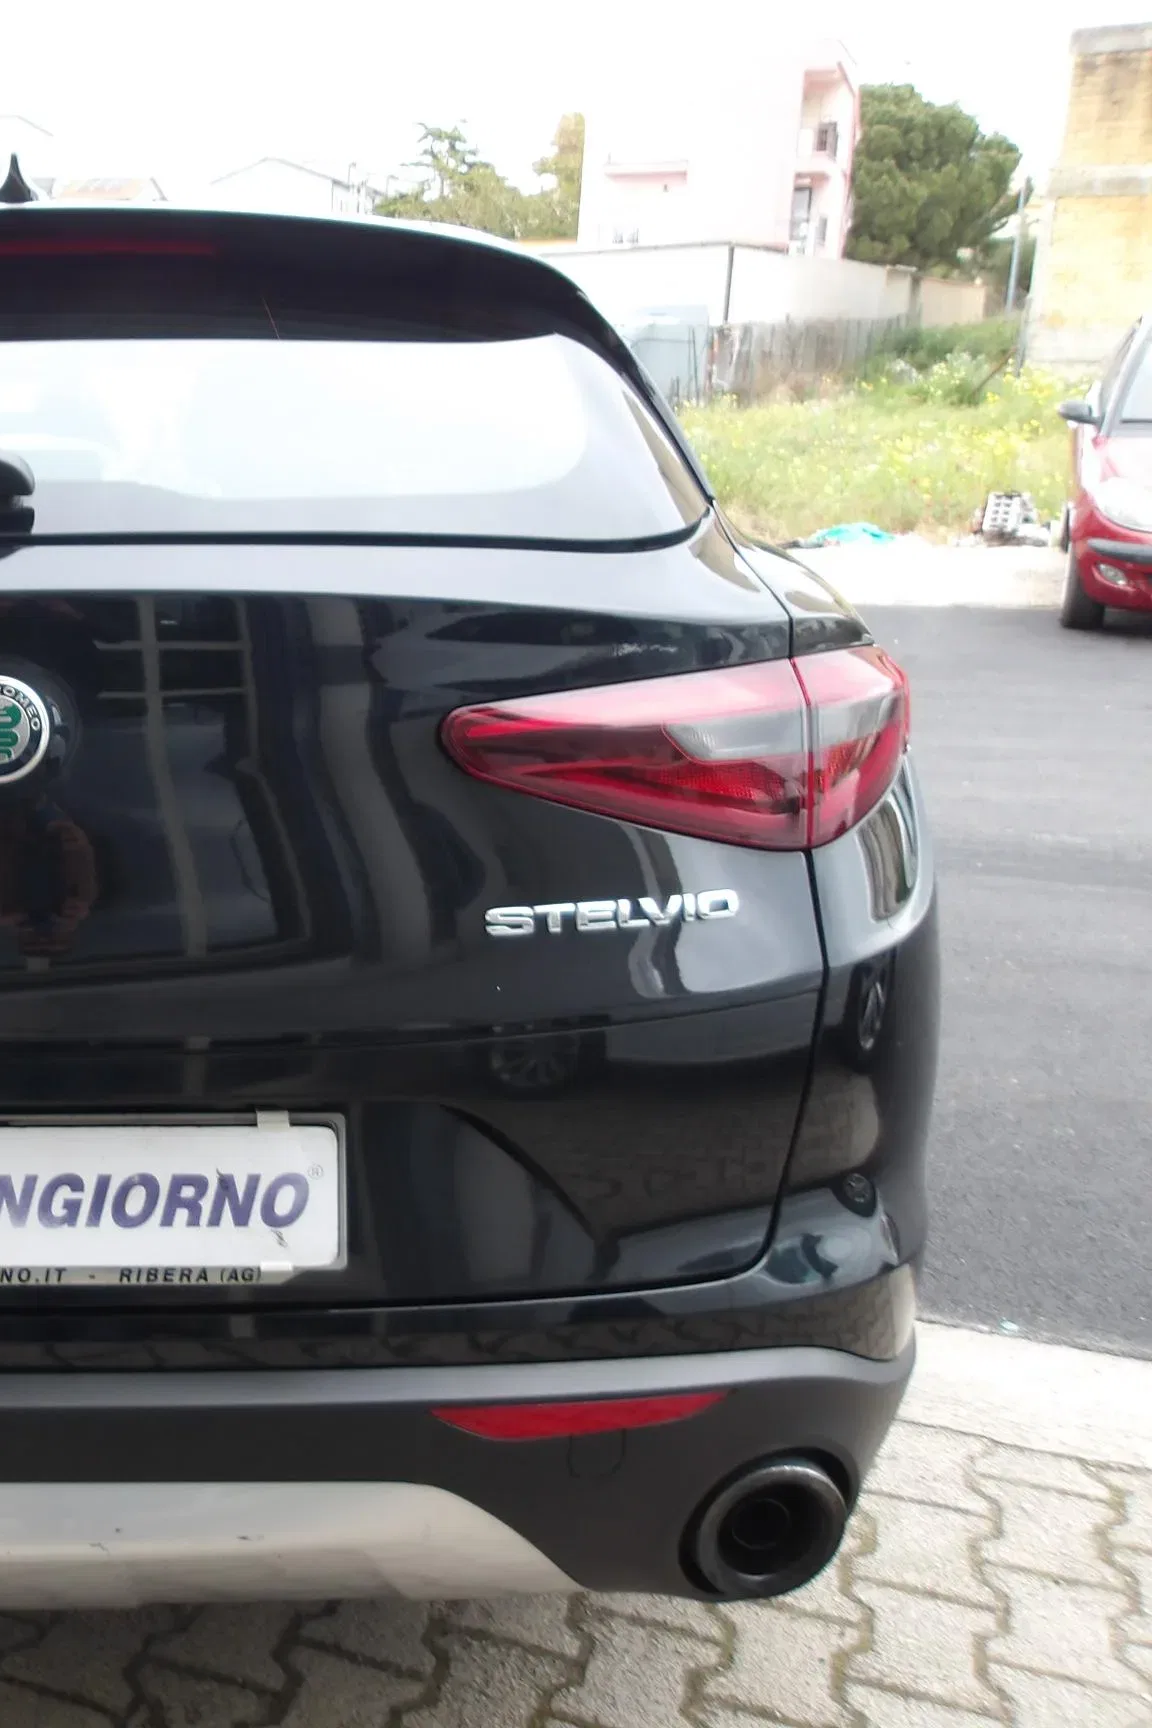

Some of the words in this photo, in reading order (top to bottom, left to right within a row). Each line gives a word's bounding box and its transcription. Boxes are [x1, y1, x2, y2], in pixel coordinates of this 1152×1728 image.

[485, 888, 739, 936] STELVIO
[118, 1267, 209, 1284] RIBERA
[219, 1266, 262, 1284] (AG)
